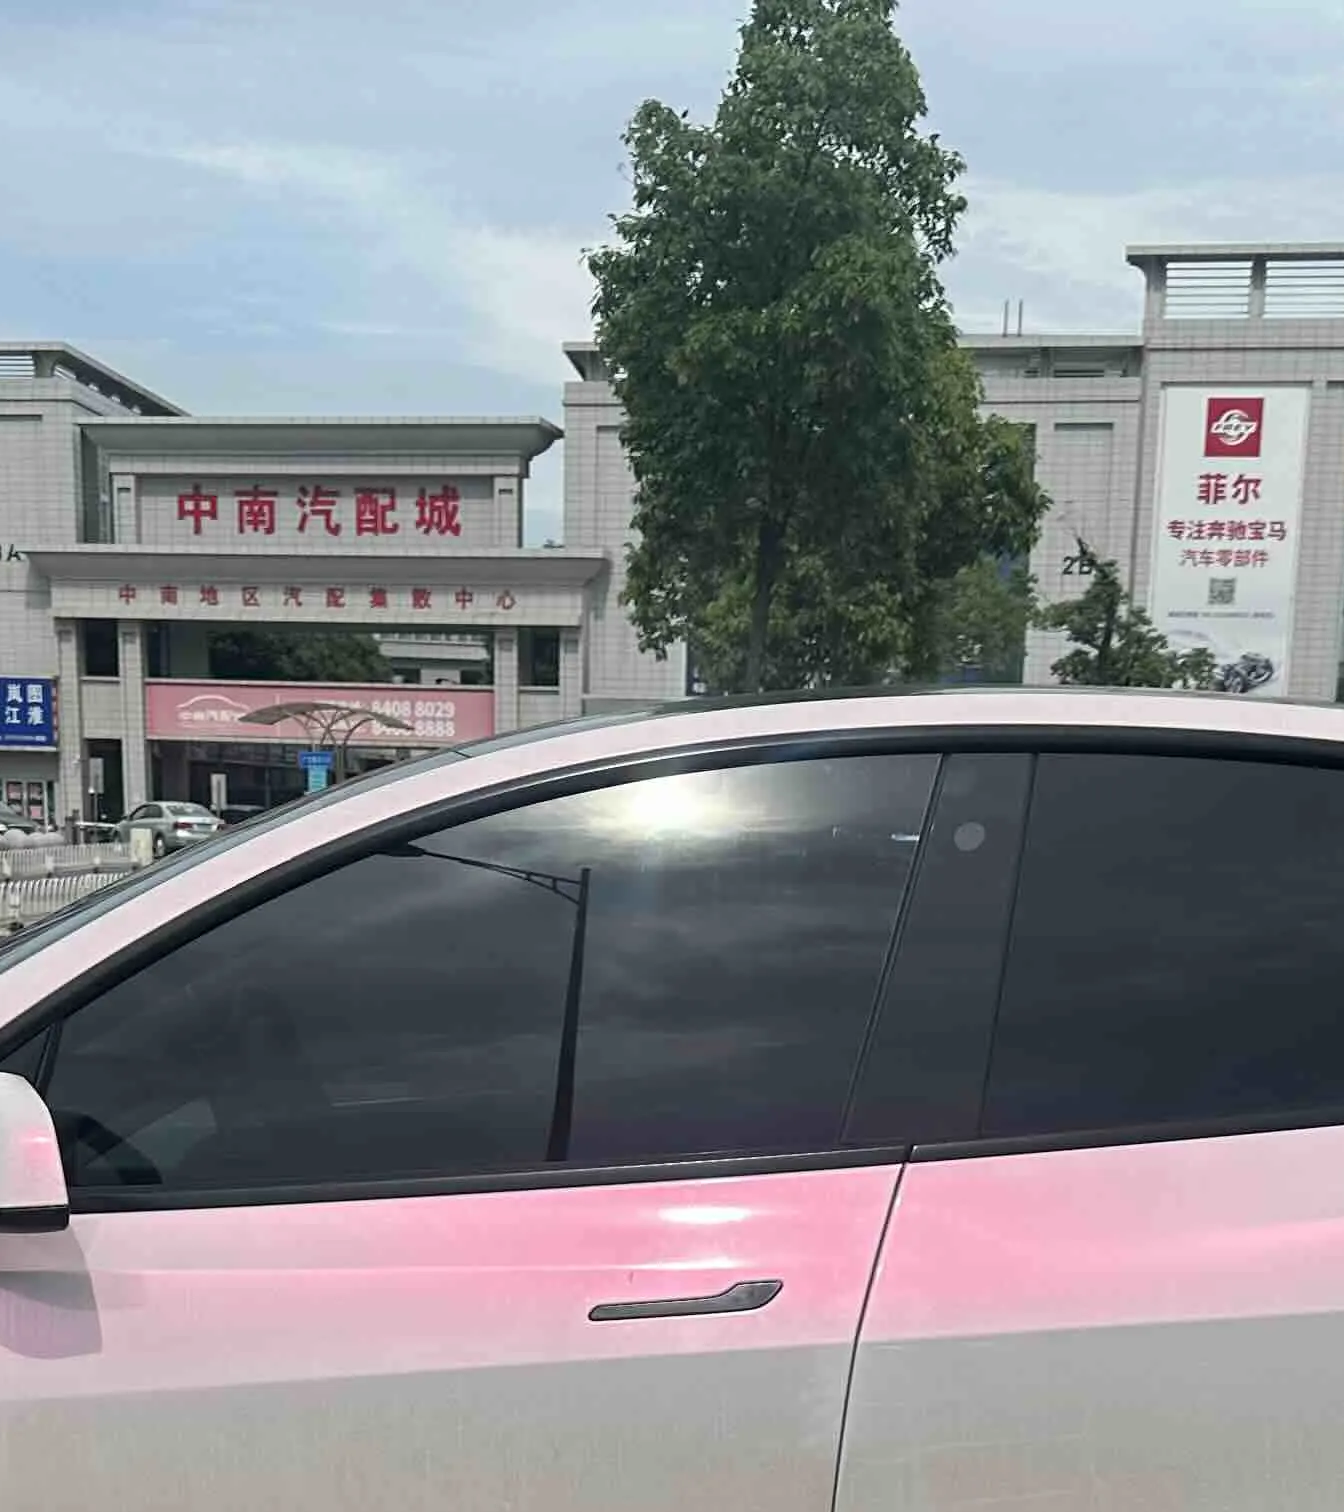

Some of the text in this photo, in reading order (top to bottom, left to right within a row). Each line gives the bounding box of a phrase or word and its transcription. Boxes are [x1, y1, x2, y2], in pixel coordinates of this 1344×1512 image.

[1197, 473, 1263, 505] 菲尔
[177, 483, 462, 537] 中南汽配城
[1167, 520, 1287, 541] 专注奔驰宝马
[1179, 549, 1269, 568] 汽车零部件
[117, 584, 517, 610] 中南地区汽配集散中心
[415, 701, 455, 719] 8029
